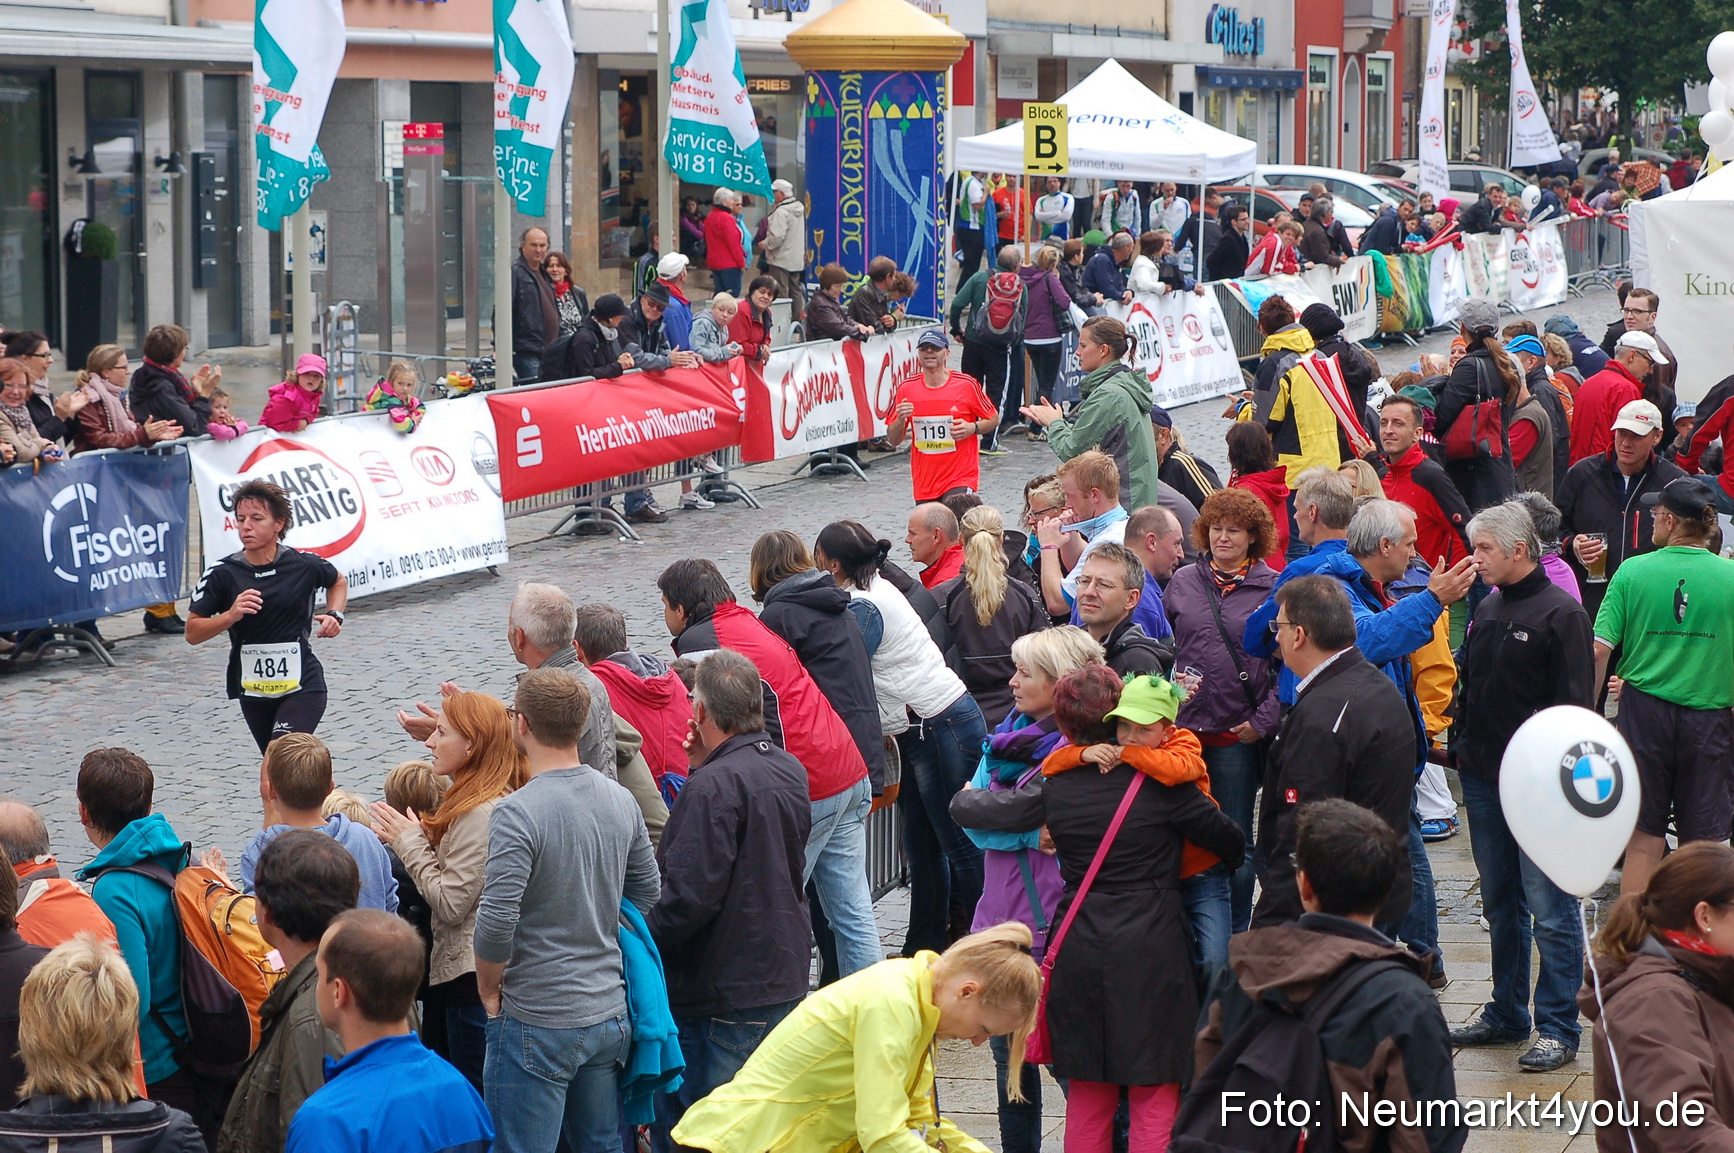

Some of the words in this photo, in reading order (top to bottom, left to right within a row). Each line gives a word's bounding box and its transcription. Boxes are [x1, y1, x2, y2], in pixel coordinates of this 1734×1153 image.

[1028, 106, 1063, 119] Block
[1035, 125, 1058, 159] B
[575, 414, 641, 455] Herzlich
[637, 406, 717, 441] willkommen
[921, 425, 946, 440] 119
[416, 454, 451, 478] KIA
[379, 501, 423, 520] SEAT
[69, 514, 171, 569] Fischer
[378, 559, 399, 580] Tel.
[253, 657, 289, 679] 484
[1561, 741, 1618, 771] BMW
